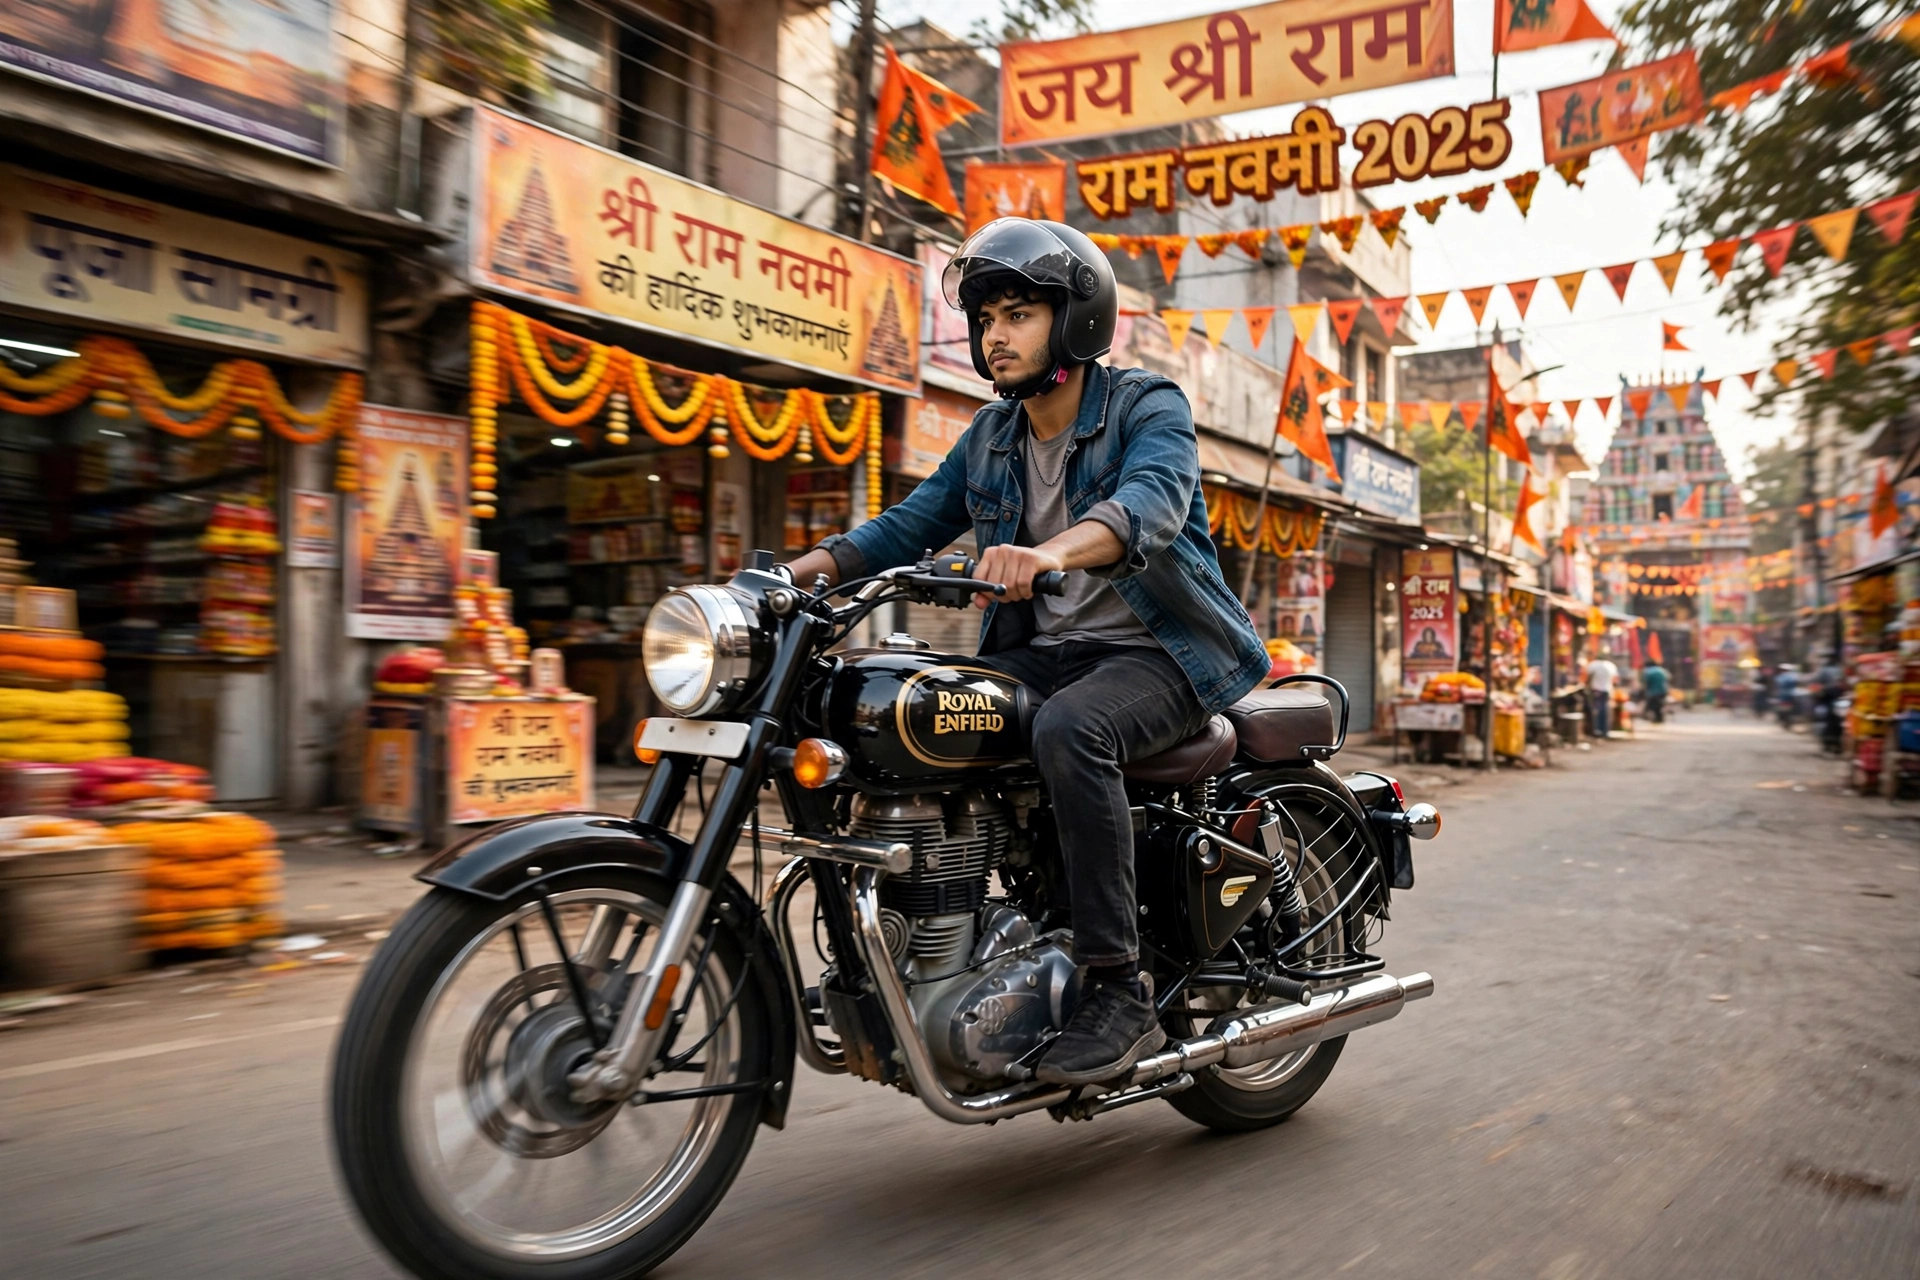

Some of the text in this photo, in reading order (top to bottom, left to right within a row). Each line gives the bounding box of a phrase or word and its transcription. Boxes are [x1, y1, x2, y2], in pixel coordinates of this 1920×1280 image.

[1018, 0, 1431, 123] जय श्री राम
[1077, 101, 1509, 219] राम नवमी 2025
[598, 176, 852, 311] श्री राम नवमी
[598, 255, 852, 360] की हार्दिक शुभकामनाएँ
[1401, 575, 1422, 595] श्री
[934, 714, 1004, 735] ENFIELD
[937, 691, 996, 712] ROYAL
